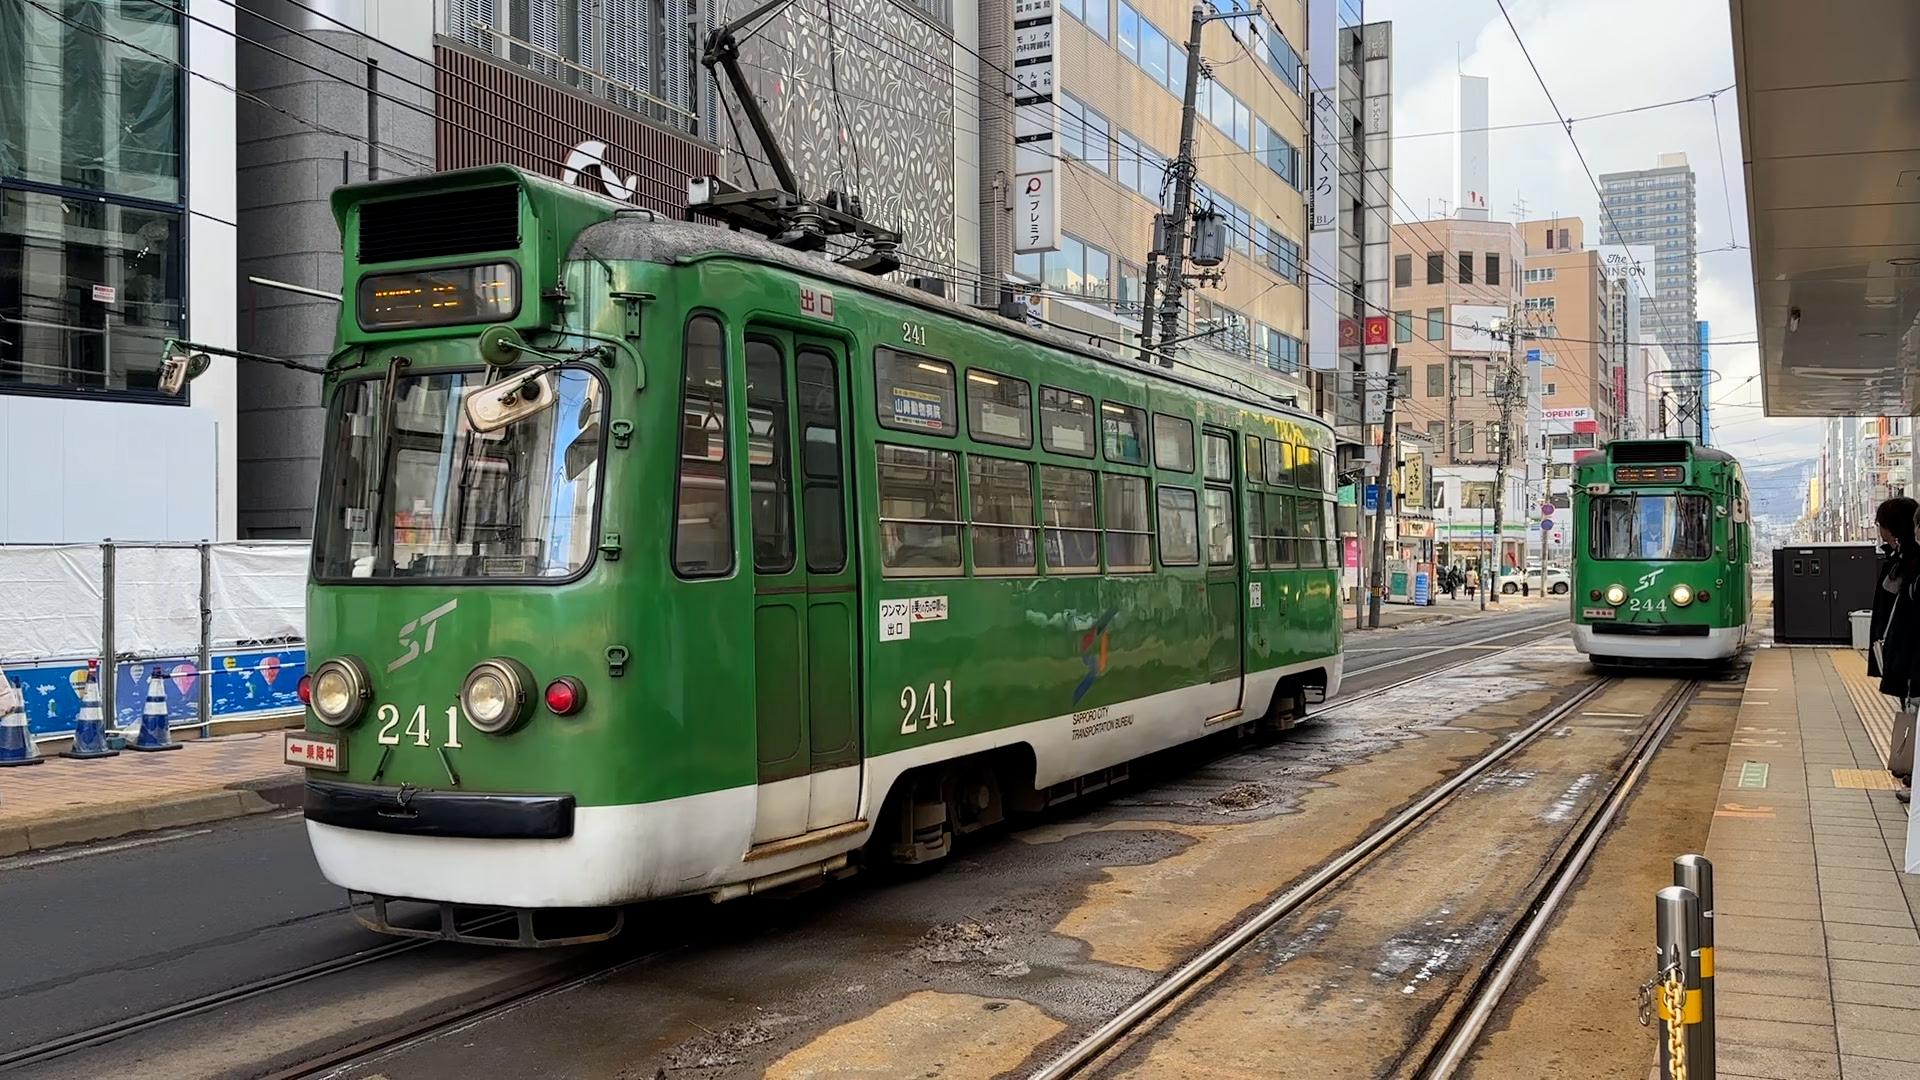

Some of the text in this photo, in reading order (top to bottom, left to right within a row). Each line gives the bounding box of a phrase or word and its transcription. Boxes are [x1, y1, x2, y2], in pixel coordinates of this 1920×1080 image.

[1016, 31, 1050, 43] モリタ
[1316, 153, 1332, 196] くろ
[1606, 254, 1627, 264] The
[1604, 266, 1646, 281] INSON
[800, 288, 833, 316] 出口
[902, 322, 927, 347] 241
[1574, 409, 1588, 417] 5F
[881, 603, 908, 618] ワンマン
[1629, 598, 1667, 612] 244
[387, 598, 458, 674] ST
[887, 622, 903, 636] 出口
[900, 679, 955, 735] 241
[1072, 707, 1109, 725] SAPPORO CITY
[377, 704, 462, 749] 241
[1072, 714, 1134, 740] TRANSPORTATION BUREAU
[306, 744, 335, 763] 乗降中
